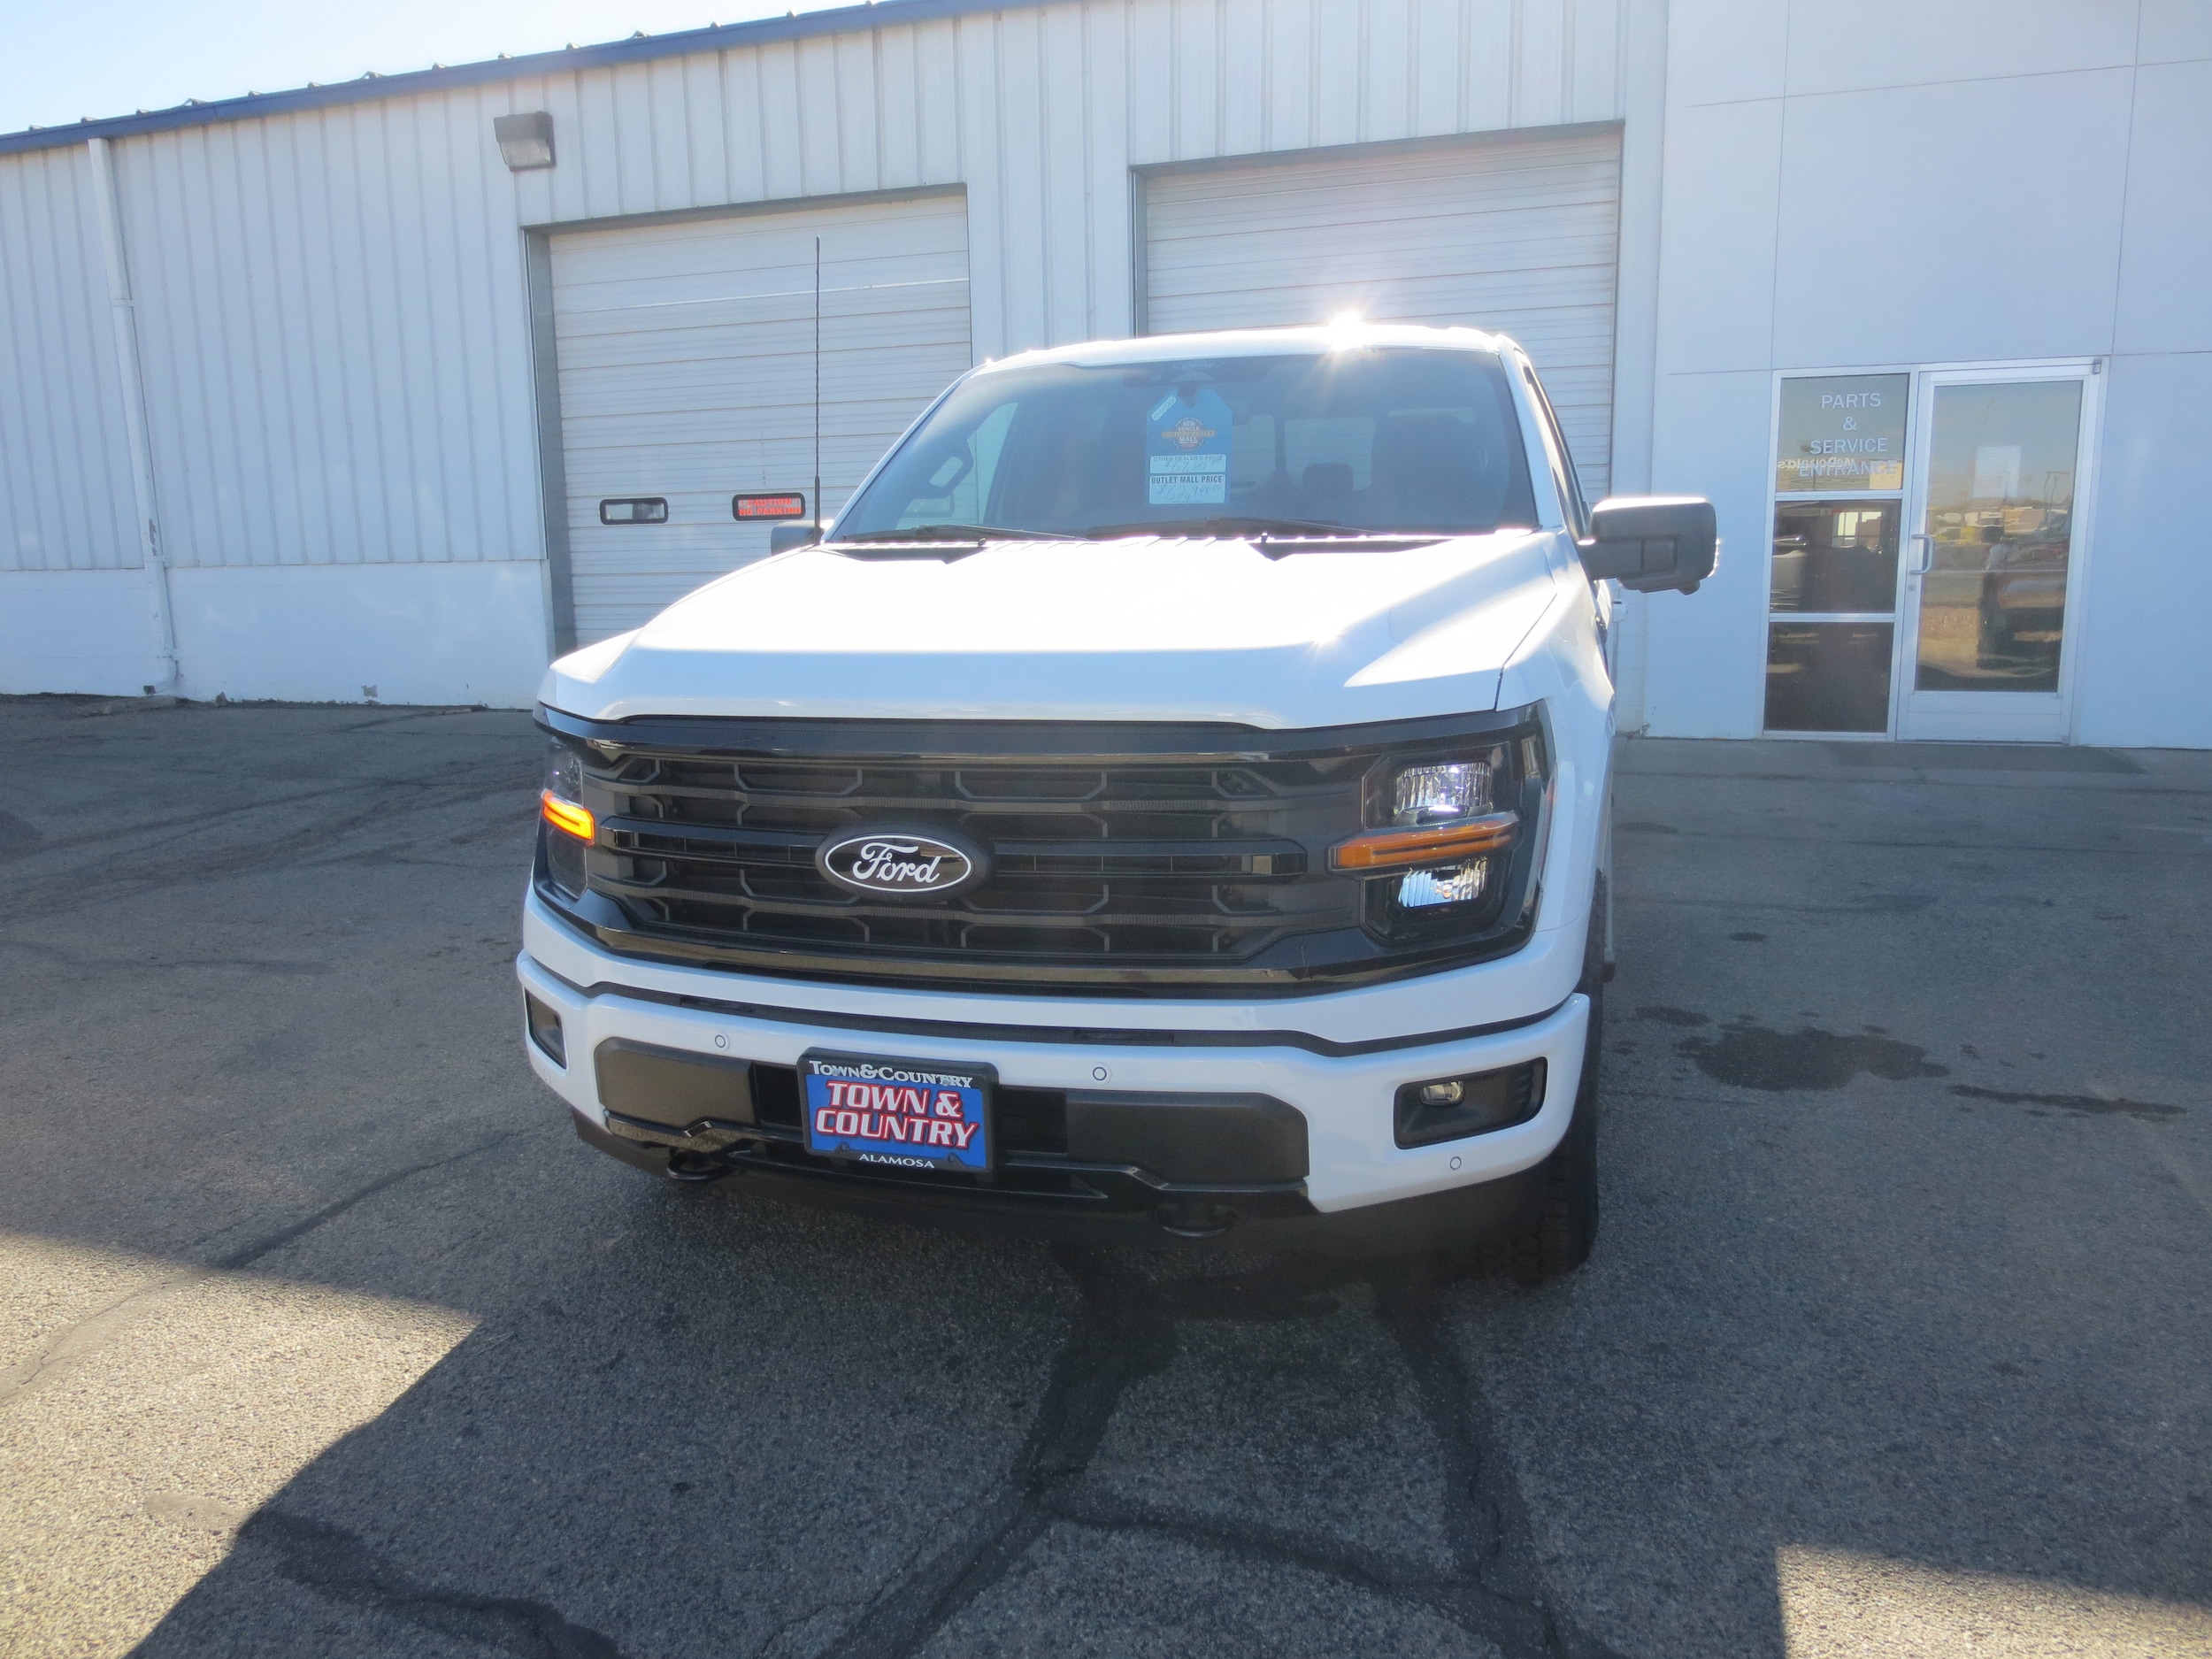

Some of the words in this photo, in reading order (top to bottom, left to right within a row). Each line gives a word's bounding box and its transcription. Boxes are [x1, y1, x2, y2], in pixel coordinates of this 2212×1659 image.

[1821, 392, 1882, 410] PARTS
[1842, 417, 1857, 431] &
[1809, 437, 1887, 454] SERVICE
[1799, 459, 1898, 477] ENTRANCE
[746, 498, 792, 507] CAUTION
[852, 842, 942, 883] Ford
[826, 1080, 930, 1115] TOWN
[934, 1090, 964, 1119] &
[816, 1108, 979, 1148] COUNTRY
[859, 1153, 935, 1169] ALAMOSA
